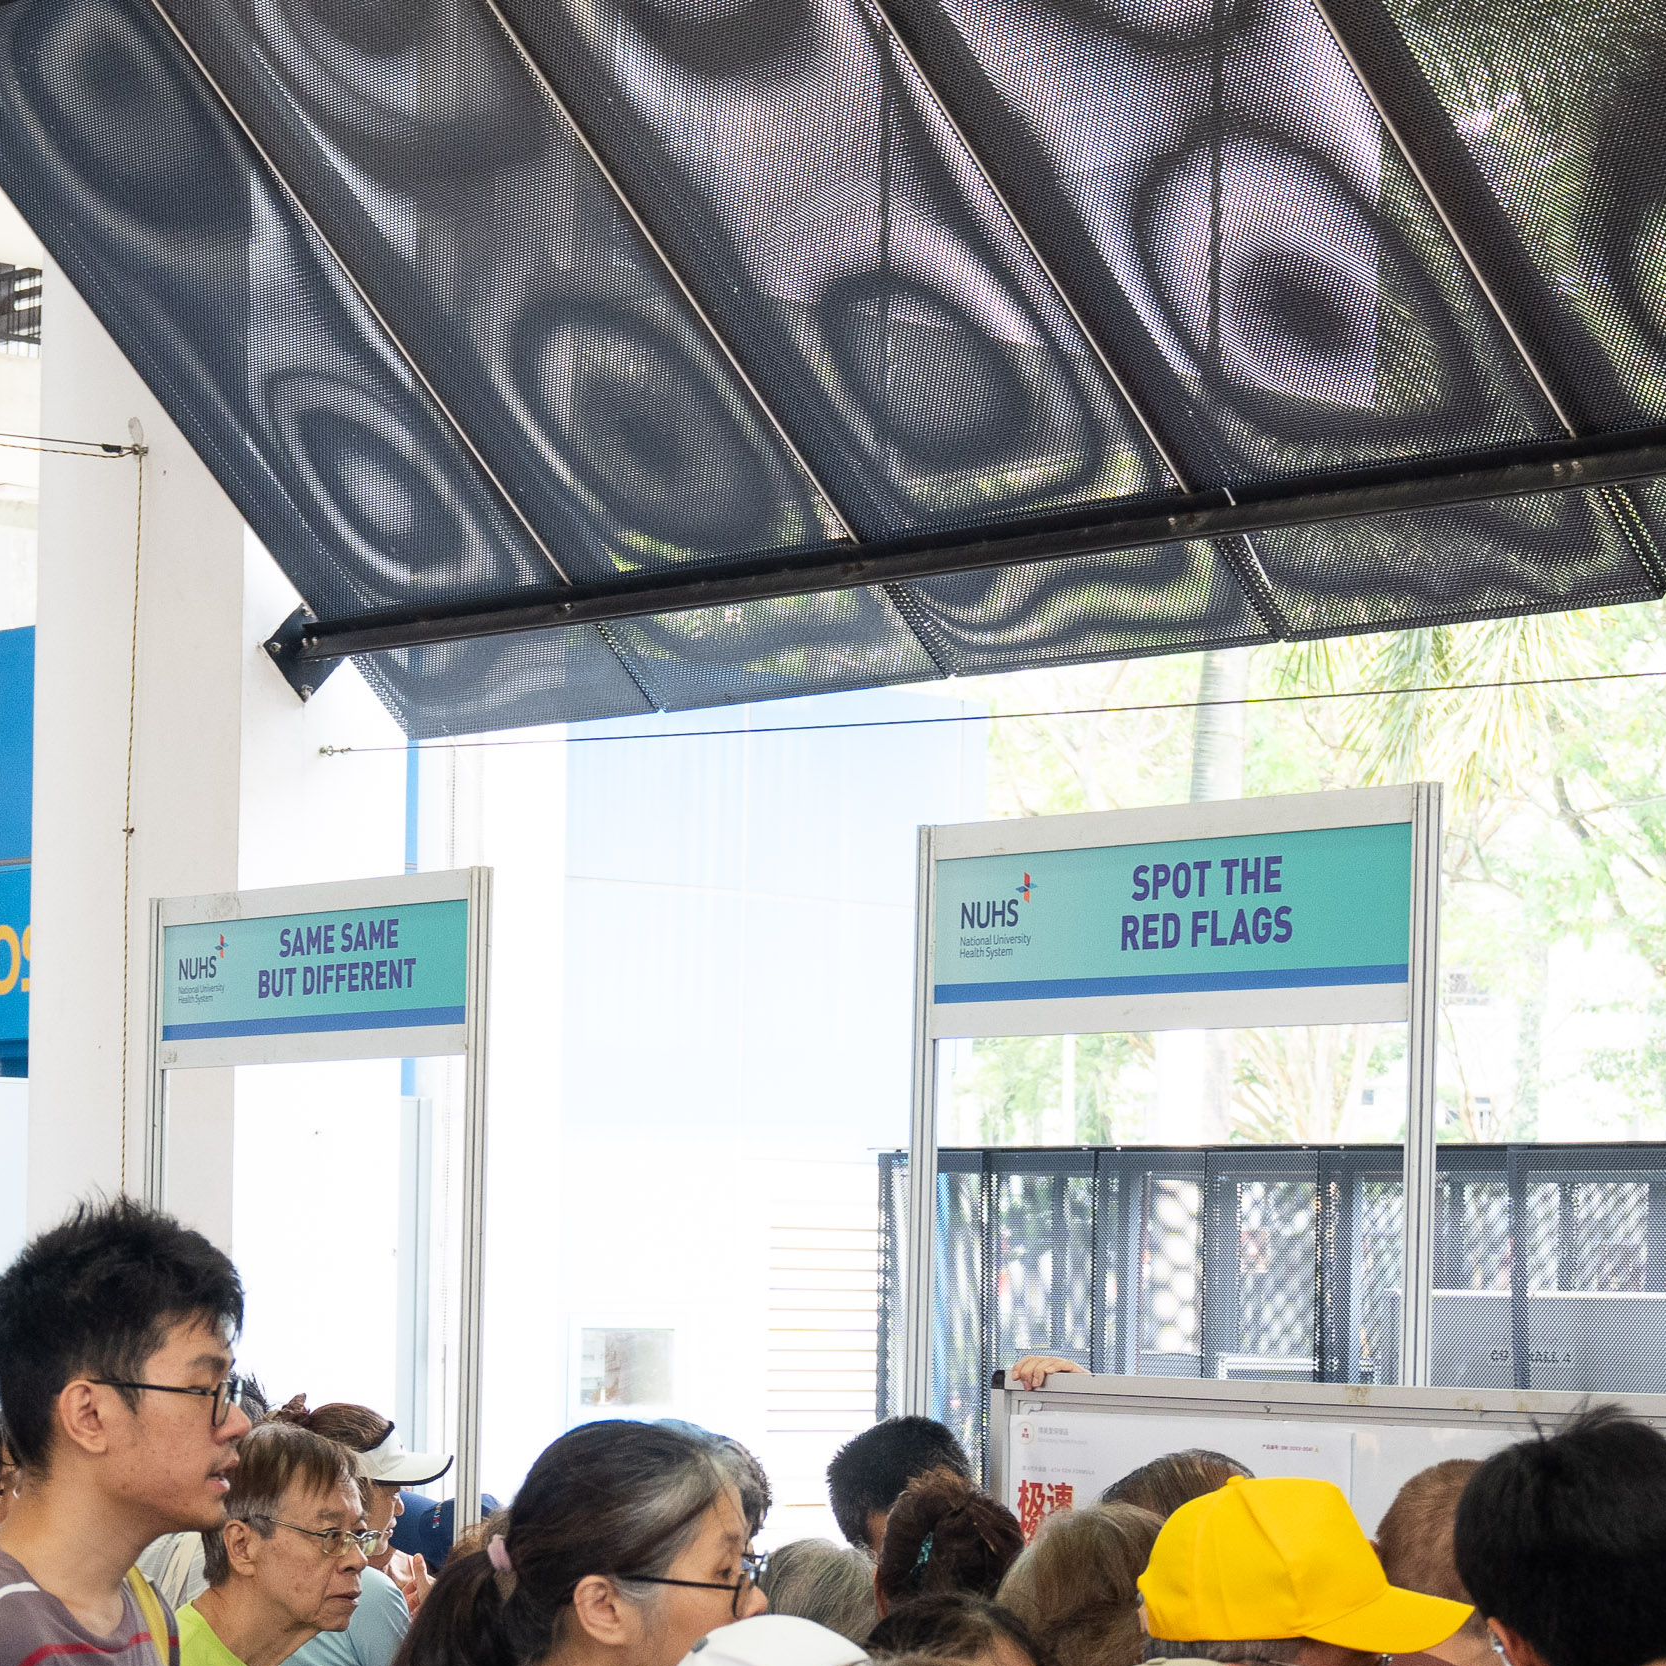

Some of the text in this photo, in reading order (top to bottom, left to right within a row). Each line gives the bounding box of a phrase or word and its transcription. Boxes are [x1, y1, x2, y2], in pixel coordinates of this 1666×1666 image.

[1132, 855, 1283, 901] SPOT THE
[960, 898, 1019, 930] NUHS
[1121, 906, 1293, 951] RED FLAGS
[279, 918, 400, 957] SAME SAME
[959, 946, 1013, 960] Health System
[960, 933, 1032, 947] National University
[178, 955, 217, 981] NUHS
[257, 957, 417, 999] BUT DIFFERENT
